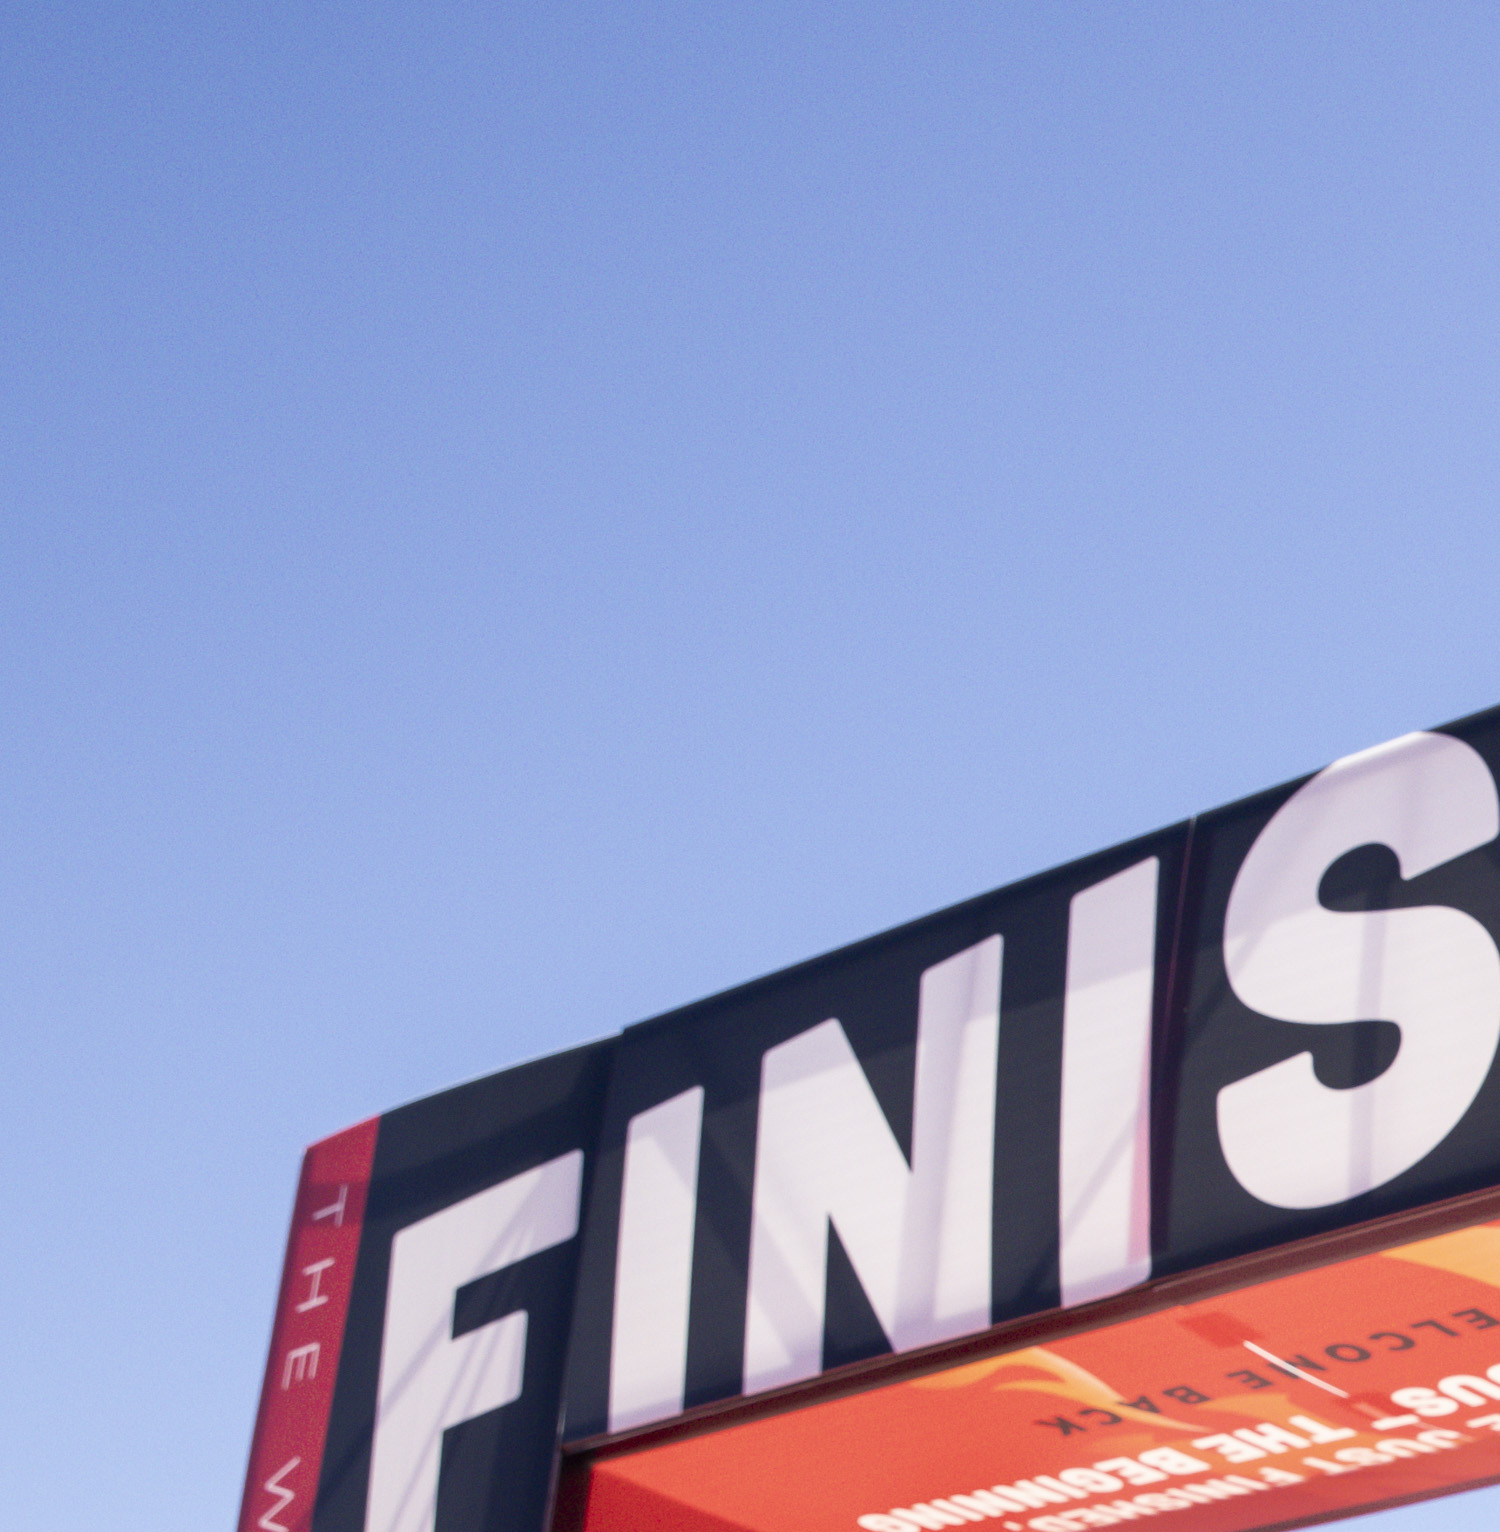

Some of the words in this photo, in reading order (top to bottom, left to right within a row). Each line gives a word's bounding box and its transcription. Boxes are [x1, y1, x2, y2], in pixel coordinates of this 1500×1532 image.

[281, 1184, 349, 1391] THE
[1034, 1384, 1211, 1438] BACK
[1192, 1414, 1357, 1465] THE
[1303, 1426, 1475, 1476] JUST
